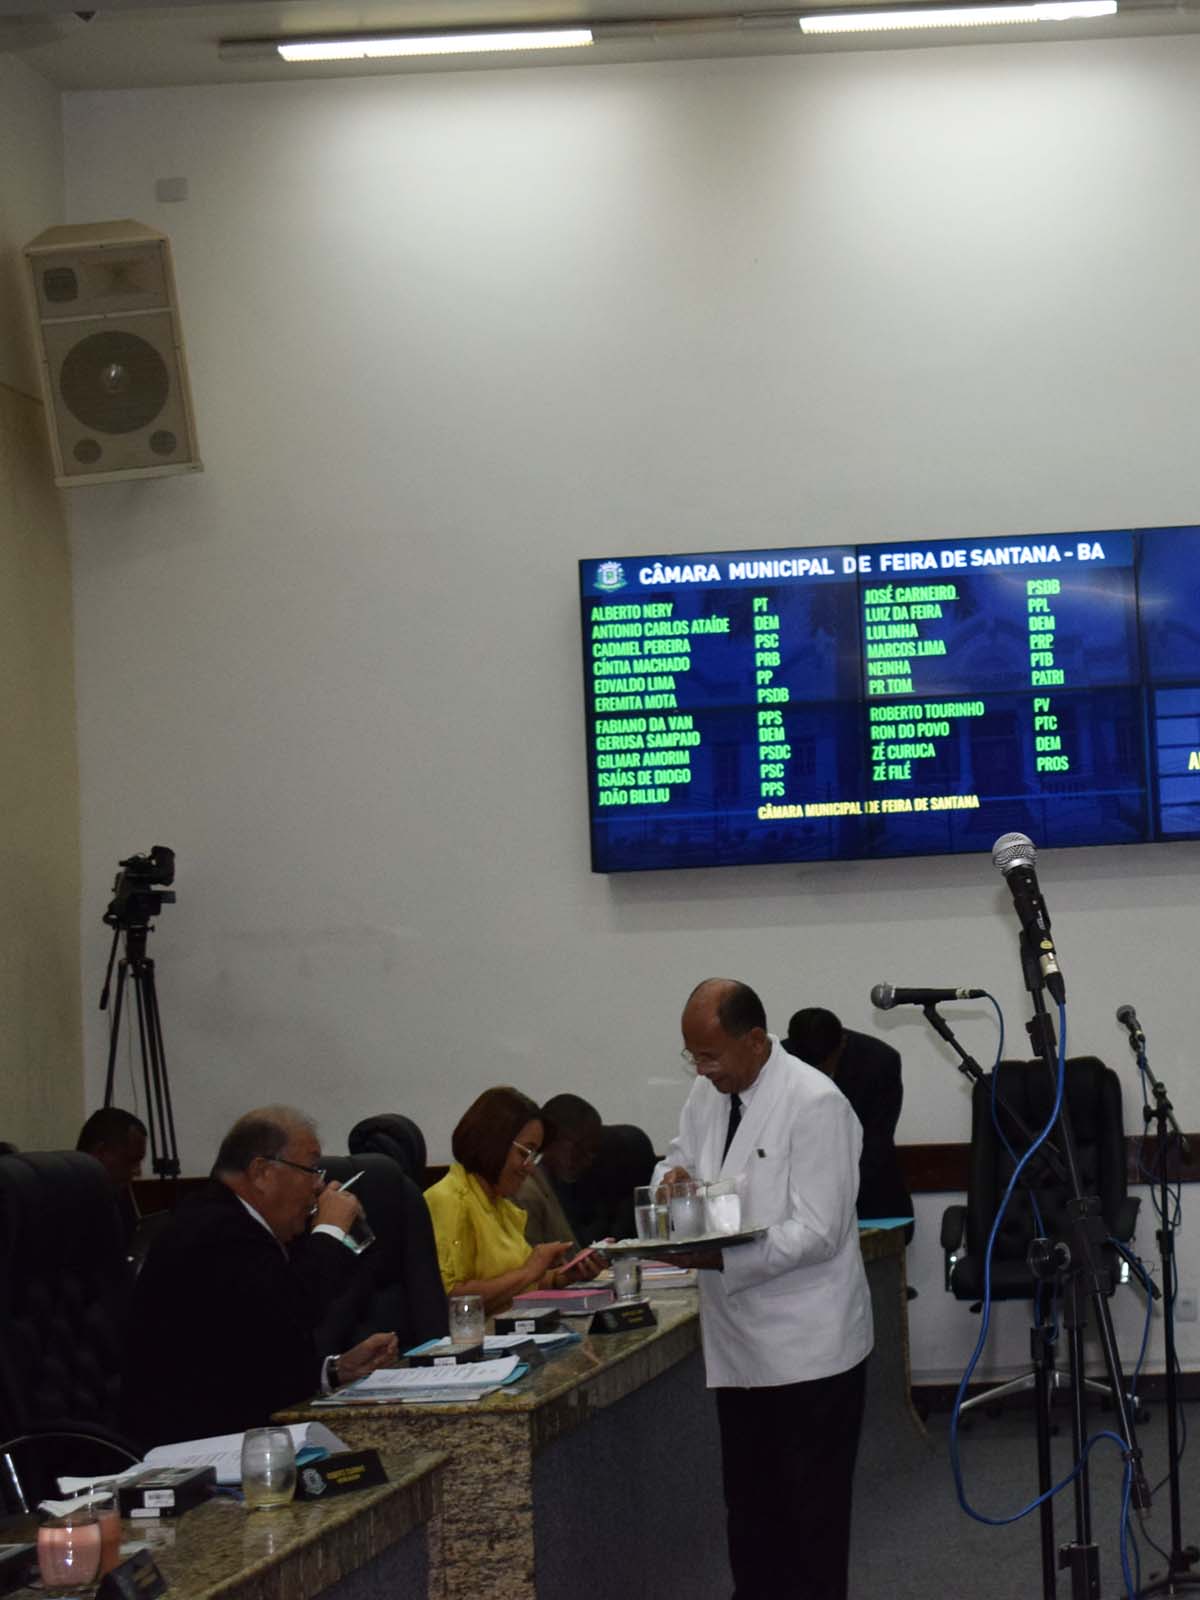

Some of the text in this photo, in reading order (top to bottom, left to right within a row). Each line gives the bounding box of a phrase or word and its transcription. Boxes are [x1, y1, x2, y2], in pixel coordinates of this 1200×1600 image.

[639, 562, 720, 585] CÂMARA
[728, 557, 835, 580] MUNICIPAL
[843, 555, 872, 574] DE
[880, 552, 937, 571] FEIRA
[940, 549, 968, 568] DE
[970, 545, 1061, 567] SANTANA
[1077, 542, 1105, 560] BA
[864, 583, 959, 605] JOSÉ CARNEIRO
[1027, 579, 1061, 596] PSDB
[591, 603, 673, 621] ALBERTO NERY
[753, 597, 768, 613] PT
[865, 603, 943, 622] LUIZ DA FEIRA
[1027, 597, 1051, 613] PPL
[592, 614, 731, 640] ANTONIO CARLOS ATAÍDE
[753, 615, 780, 631] DEM
[866, 623, 919, 641] LULINHA
[1028, 615, 1056, 631] DEM
[592, 638, 692, 658] CADMIEL PEREIRA
[754, 633, 780, 649] PSC
[867, 639, 947, 659] MARCOS LIMA
[593, 656, 691, 676] CÍNTIA MACHADO
[755, 652, 781, 667] PRB
[868, 659, 912, 676] NEINHA
[1030, 652, 1054, 668] PTB
[594, 675, 676, 695] EDVALDO LIMA
[756, 670, 774, 686] PP
[595, 693, 678, 713] EREMITA MOTA
[757, 687, 790, 704] PSDB
[870, 701, 985, 722] ROBERTO TOURINHO
[1034, 697, 1051, 713] PV
[595, 715, 694, 735] FABIANO DA VAN
[757, 711, 783, 726] PPS
[1034, 715, 1058, 731] PTC
[758, 727, 785, 742] DEM
[870, 721, 950, 740] RON DO POVO
[595, 731, 701, 751] GERUSA SAMPAIO
[1036, 736, 1062, 752] DEM
[596, 750, 691, 769] GILMAR AMORIM
[759, 744, 792, 761] PSDC
[871, 742, 887, 761] ZÉ
[760, 764, 785, 779] PSC
[872, 760, 912, 781] ZÉ FILÉ
[1037, 755, 1070, 772] PROS
[597, 768, 692, 788] ISAÍAS DE DIOGO
[598, 787, 629, 807] JOÃO
[761, 781, 786, 797] PPS
[757, 803, 804, 820] CÂMARA
[804, 801, 863, 818] MUNICIPAL
[881, 799, 913, 814] FEIRA
[913, 798, 930, 812] DE
[930, 795, 981, 811] SANTANA
